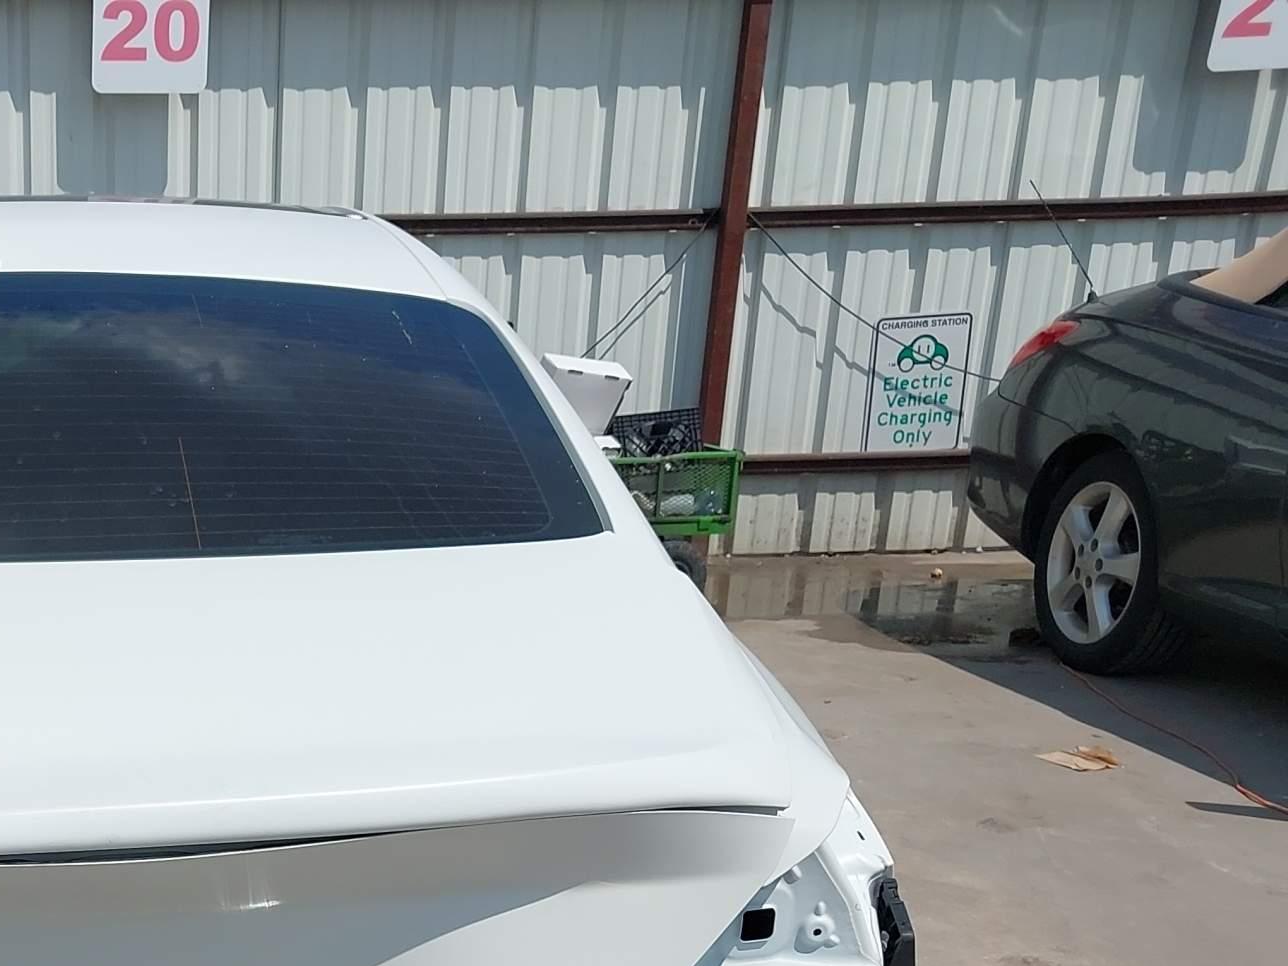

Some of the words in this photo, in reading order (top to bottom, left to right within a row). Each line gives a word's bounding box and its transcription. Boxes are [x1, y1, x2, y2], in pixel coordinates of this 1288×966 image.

[100, 0, 200, 63] 20
[881, 320, 929, 331] CHARGING
[931, 316, 969, 328] STATION
[883, 373, 953, 392] Electric
[886, 392, 949, 409] Vehicle
[877, 409, 953, 428] Charging
[893, 429, 933, 446] Only
